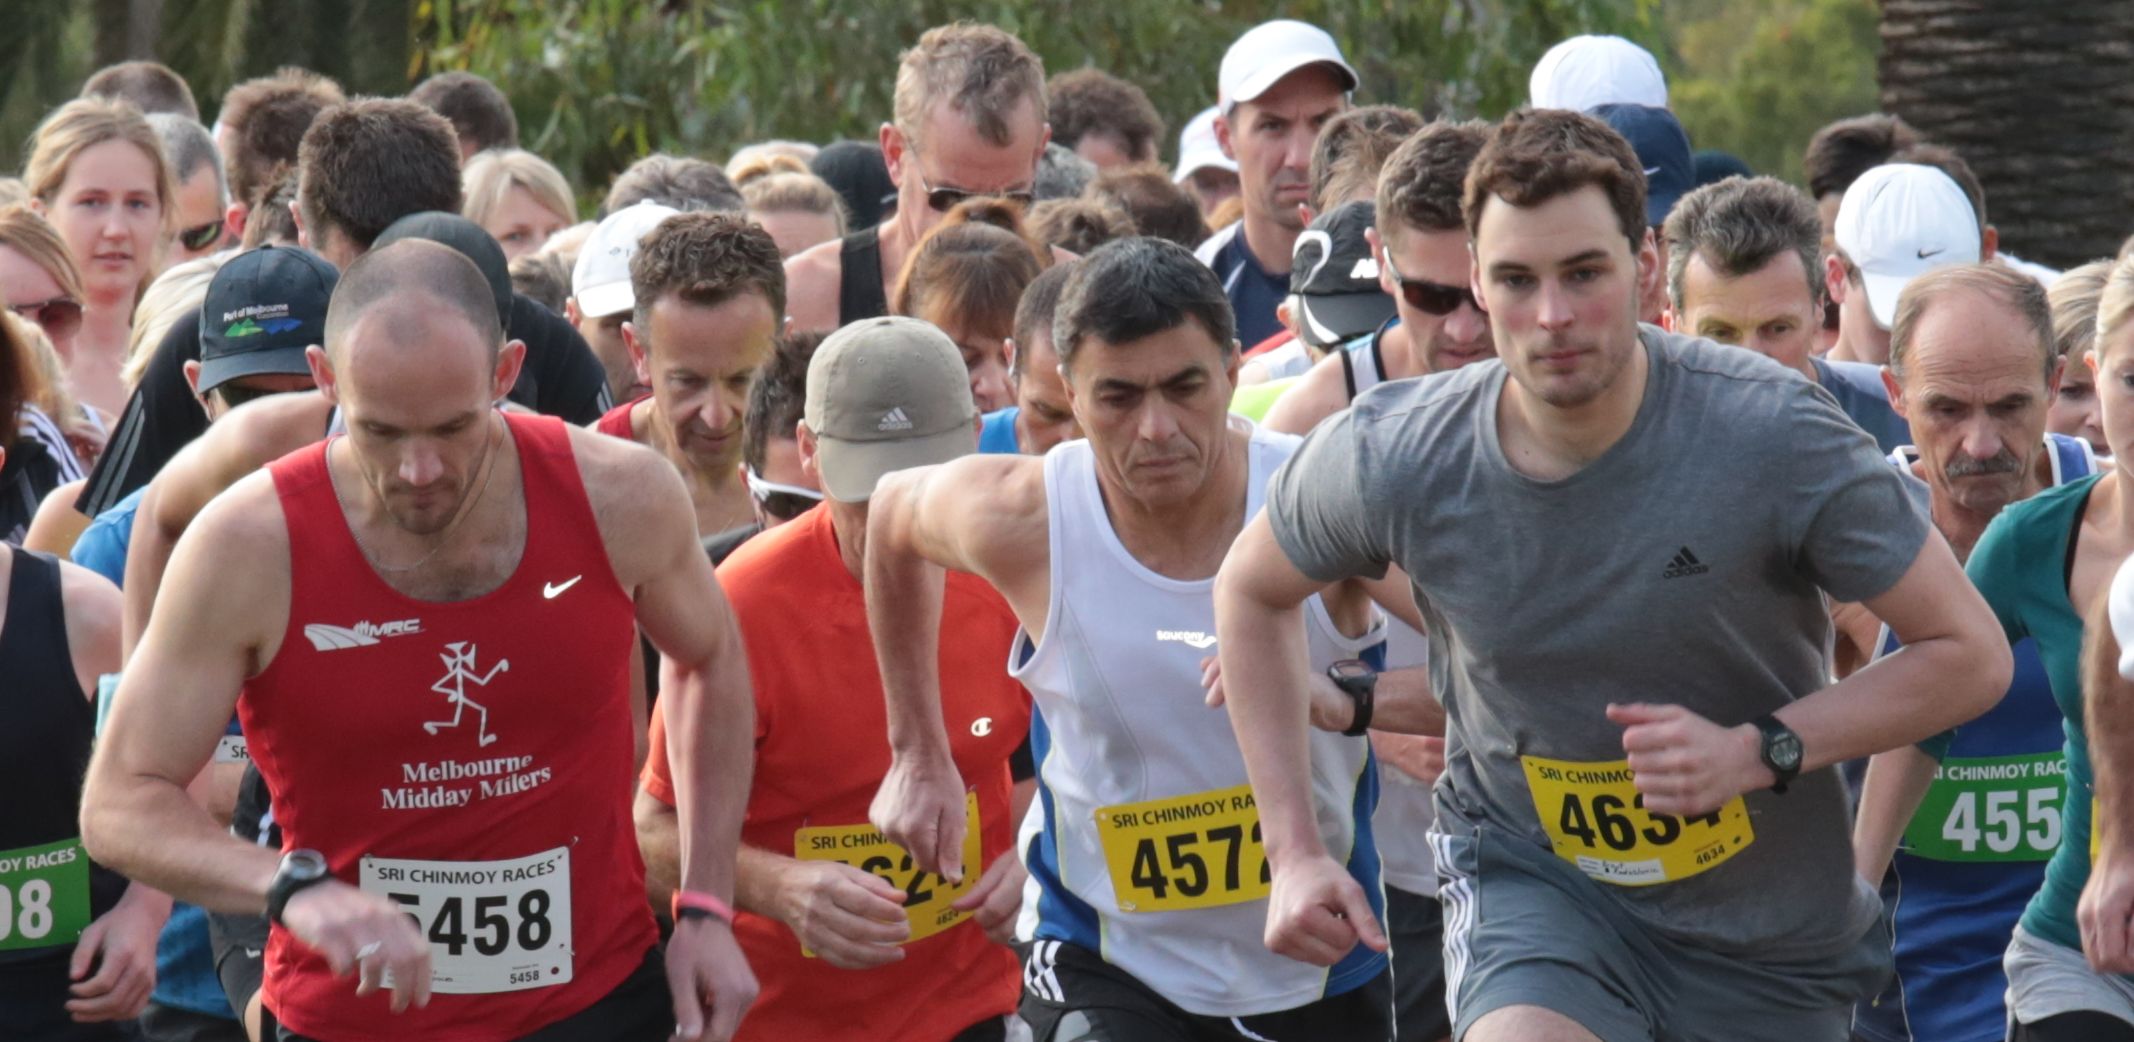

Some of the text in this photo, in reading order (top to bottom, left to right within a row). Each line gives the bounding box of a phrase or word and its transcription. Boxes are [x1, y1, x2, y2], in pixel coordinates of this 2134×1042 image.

[1663, 564, 1709, 580] adidas
[369, 619, 420, 637] MRC
[402, 755, 533, 783] Melbourne
[1538, 766, 1562, 781] SRI
[1947, 763, 2030, 781] CHINMOY
[381, 767, 552, 809] Midday Milers
[1112, 813, 1138, 829] SRI
[1142, 799, 1226, 826] CHINMOY
[811, 832, 887, 850] SRI CHIN
[25, 847, 76, 870] RACES
[1696, 844, 1726, 866] 4634
[378, 859, 556, 884] SRI CHINMOY RACES
[509, 969, 540, 985] 5458
